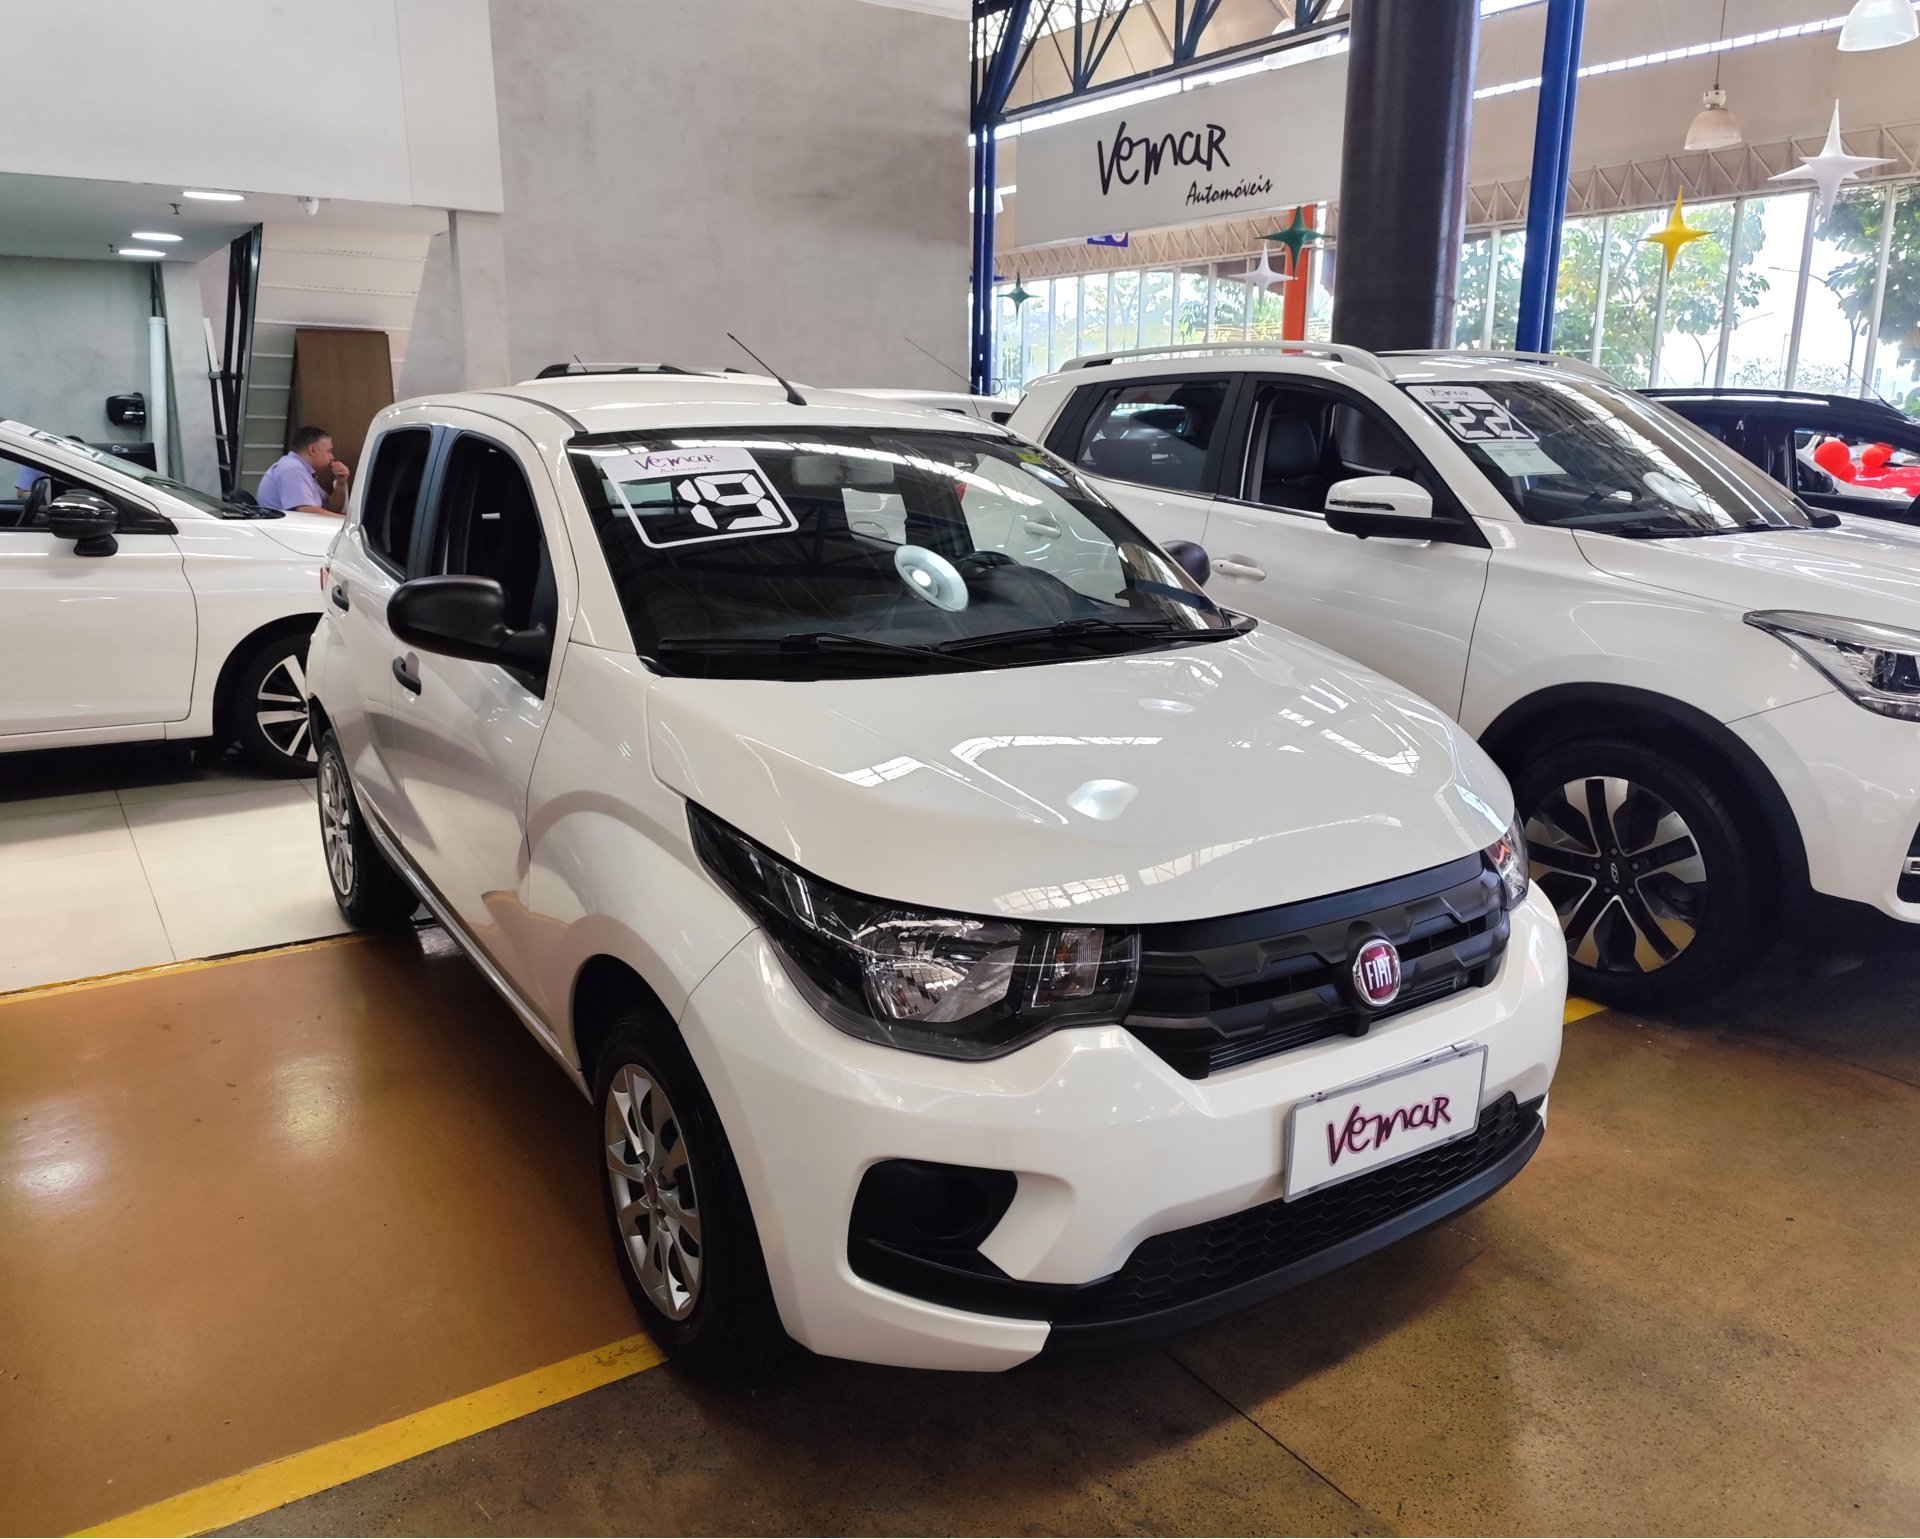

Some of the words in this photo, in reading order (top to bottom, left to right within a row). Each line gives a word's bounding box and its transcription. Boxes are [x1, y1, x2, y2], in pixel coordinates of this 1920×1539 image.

[1186, 175, 1273, 206] Automóveis
[1431, 403, 1529, 438] 22
[676, 473, 783, 530] 19
[1365, 954, 1392, 990] FIAT
